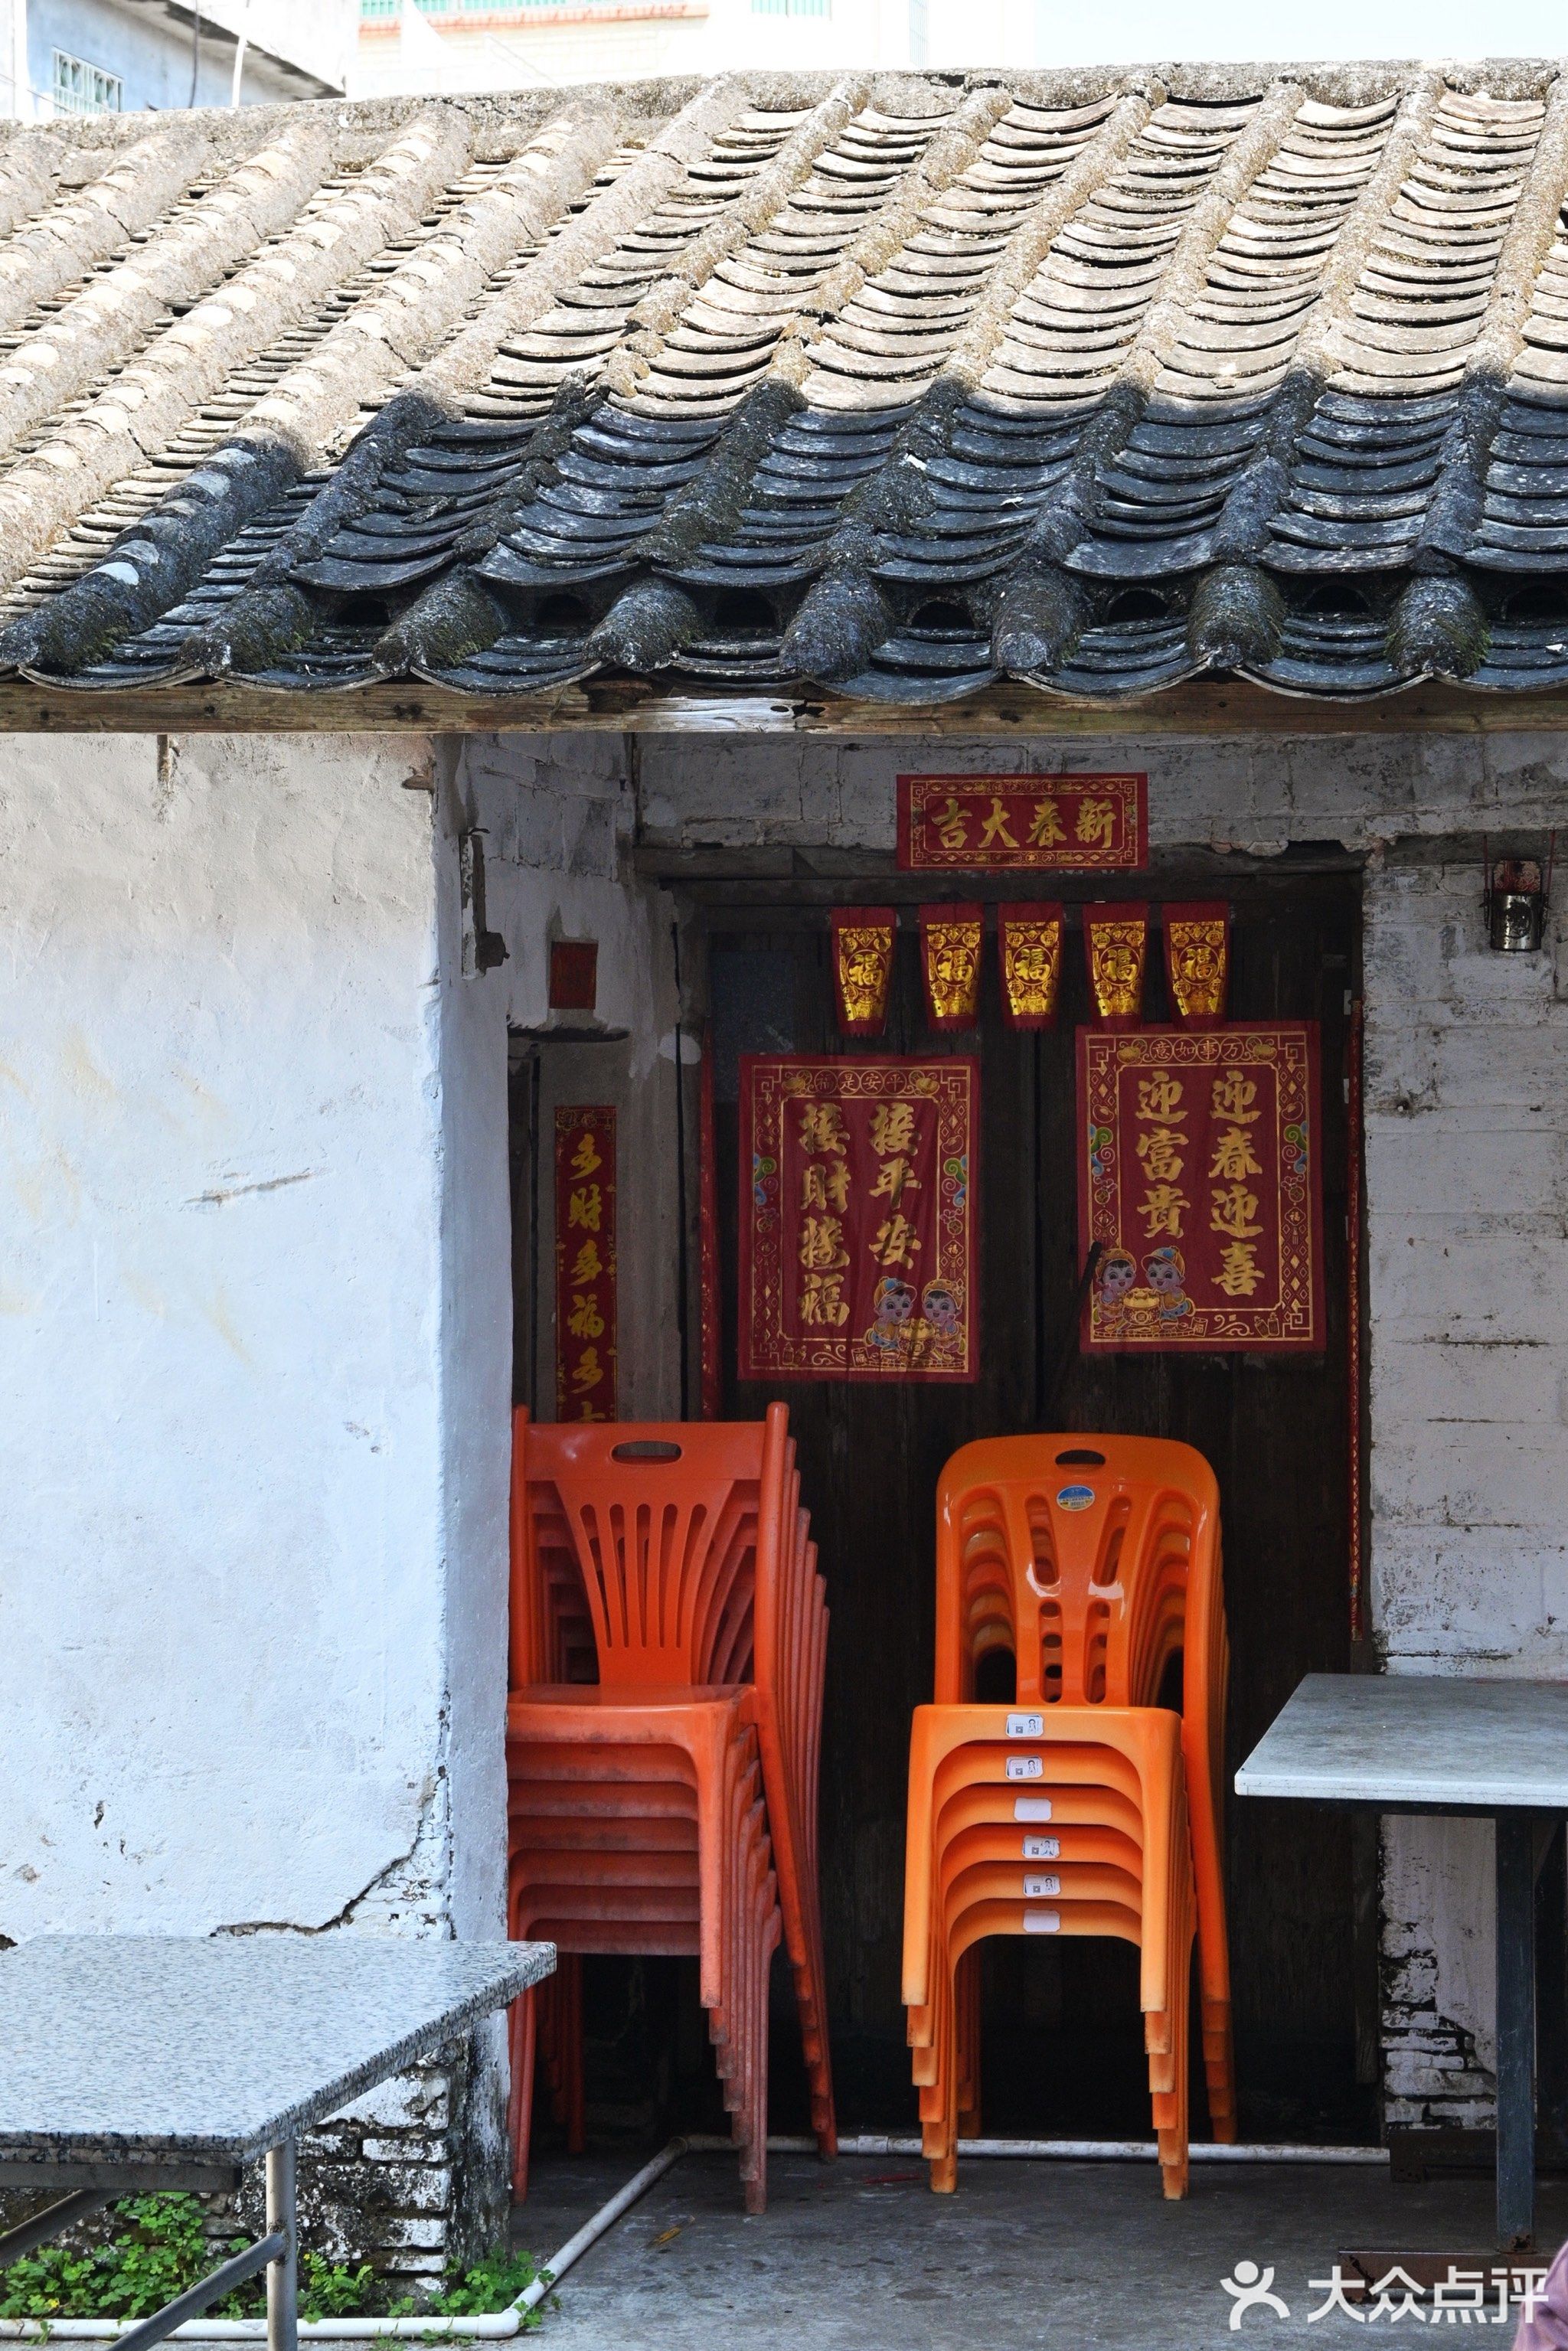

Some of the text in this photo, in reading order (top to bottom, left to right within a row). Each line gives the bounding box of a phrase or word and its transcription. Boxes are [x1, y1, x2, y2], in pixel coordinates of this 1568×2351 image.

[931, 796, 1117, 849] 新春大吉
[848, 953, 883, 986] 福
[937, 949, 973, 981] 福
[1014, 948, 1050, 981] 福
[1102, 948, 1138, 981] 福
[1181, 948, 1217, 981] 福
[1152, 1039, 1243, 1060] 万事如意
[1134, 1070, 1191, 1239] 迎富貴
[1207, 1069, 1265, 1296] 迎春迎喜
[567, 1133, 606, 1423] 多財多福多
